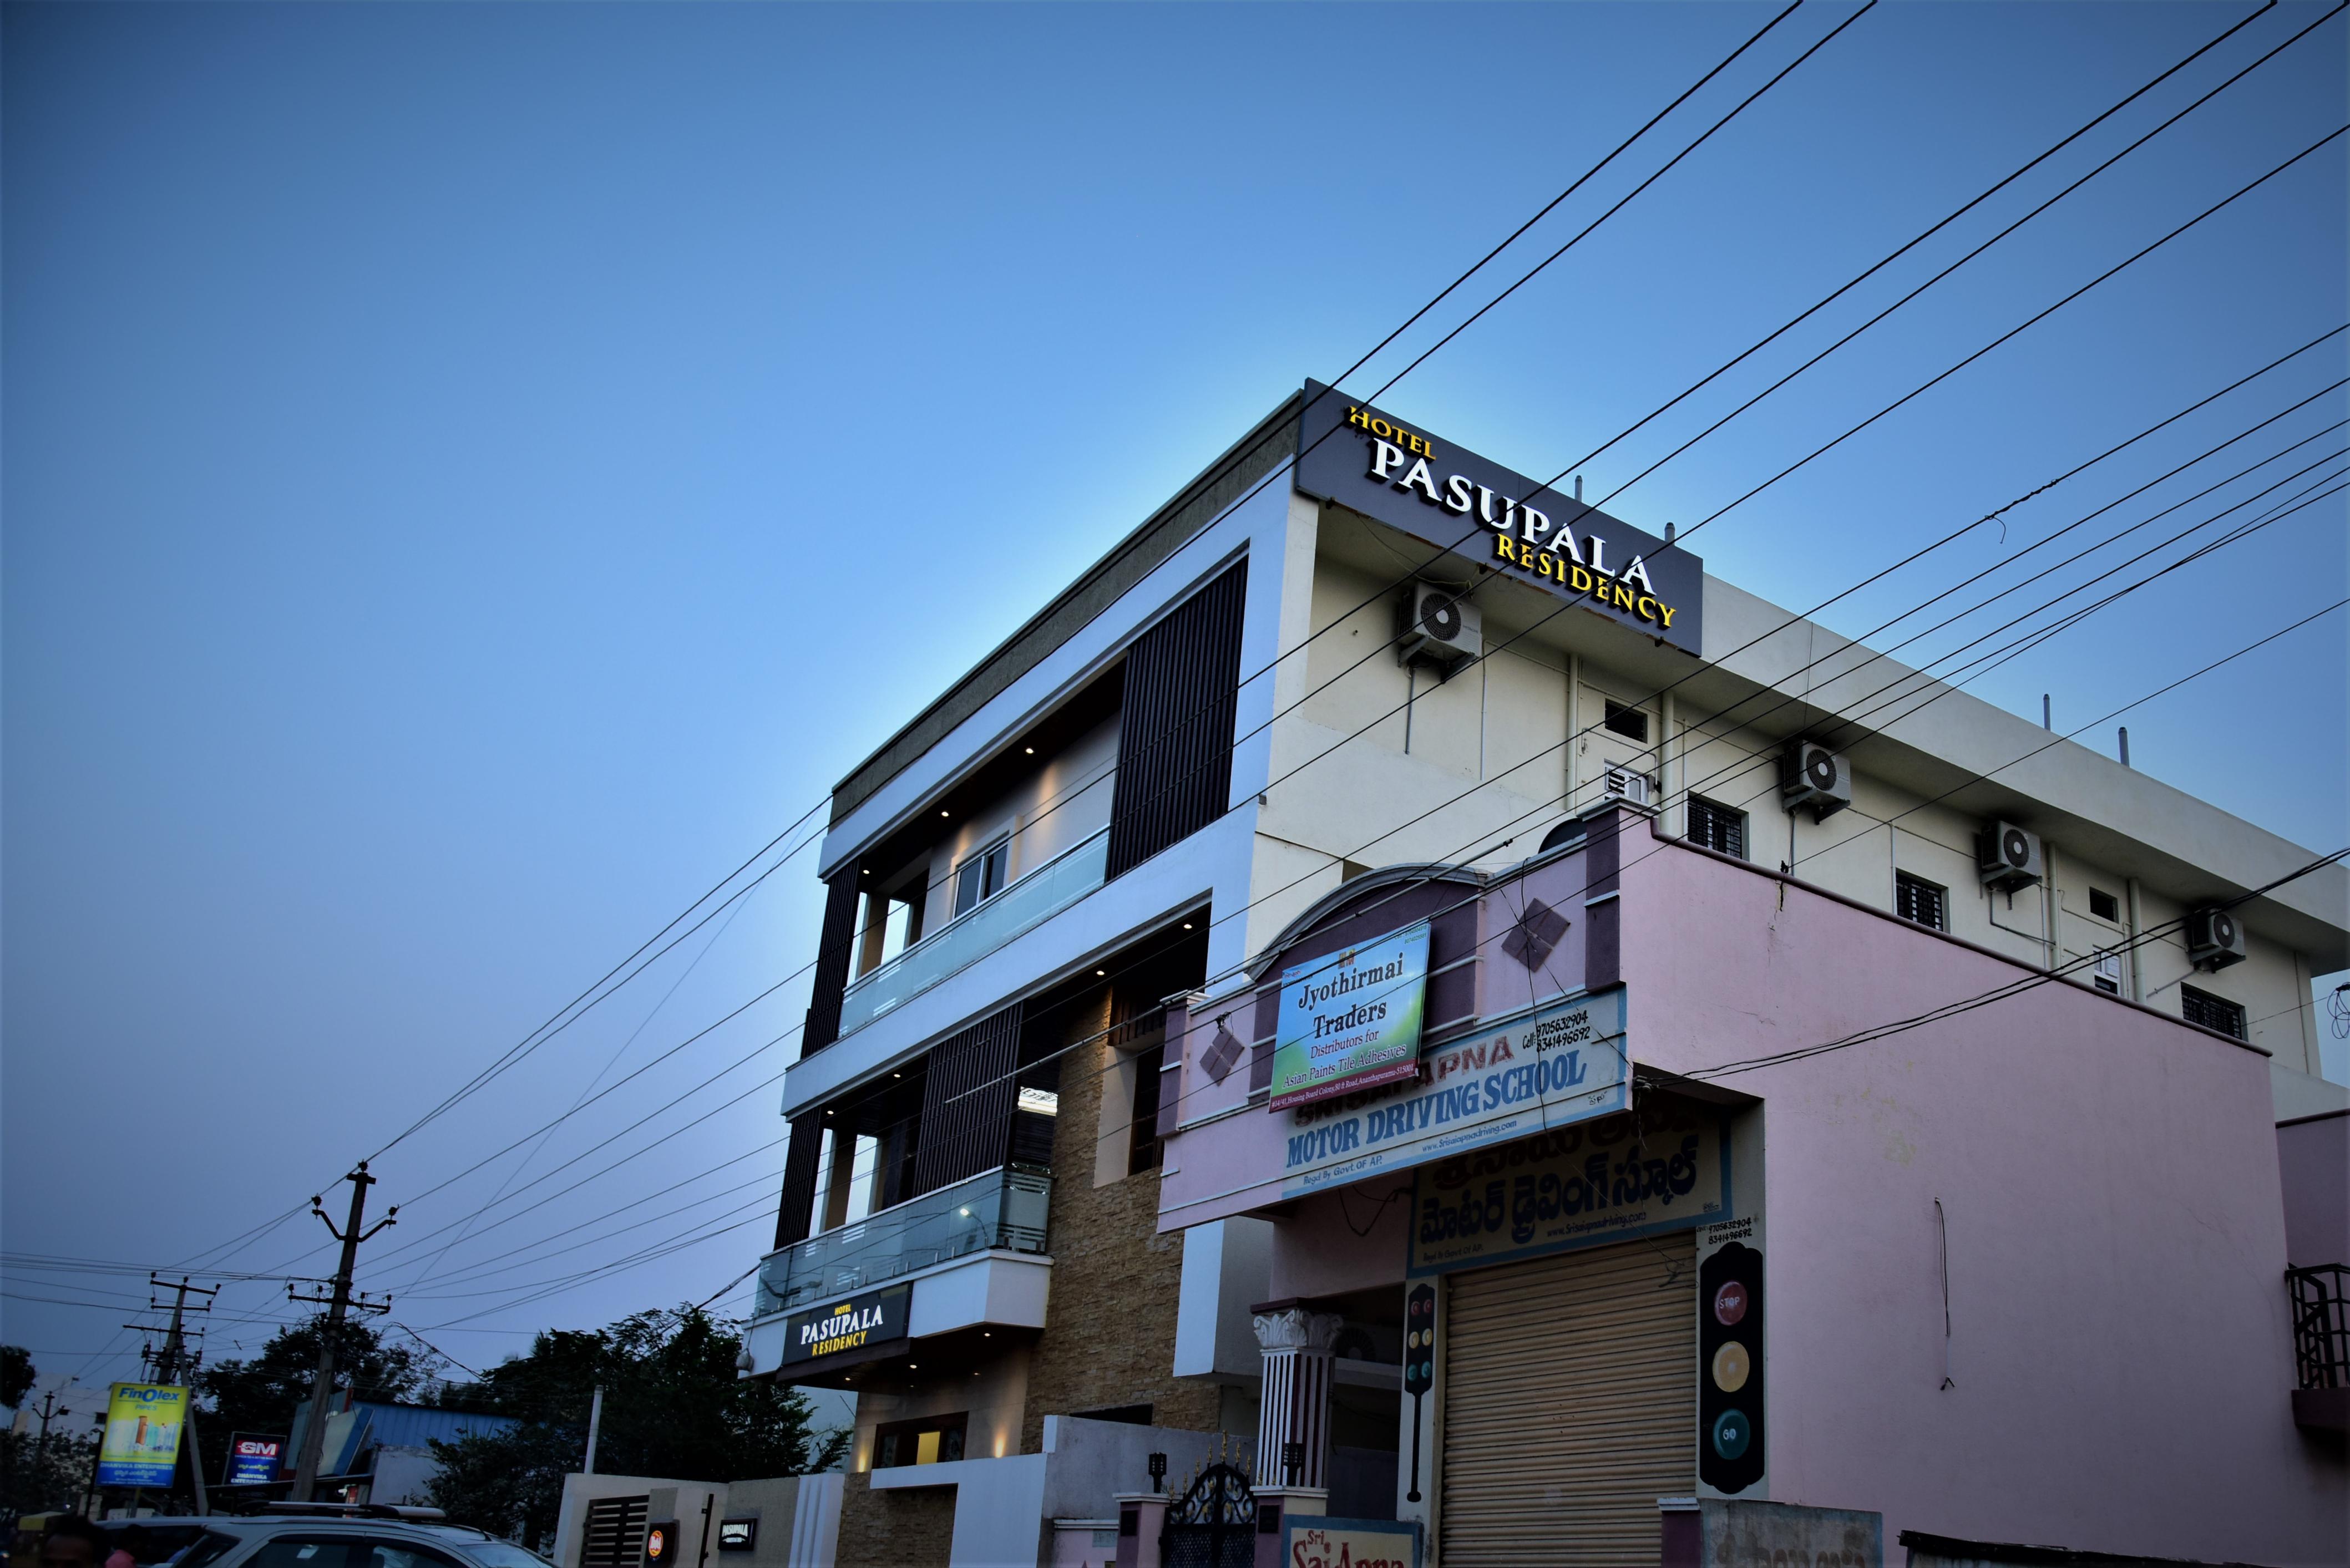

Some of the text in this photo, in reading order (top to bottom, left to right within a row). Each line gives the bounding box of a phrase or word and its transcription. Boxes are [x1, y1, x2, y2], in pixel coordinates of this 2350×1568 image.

[1348, 406, 1437, 460] HOTEL
[1370, 437, 1657, 596] PASUPALA
[1496, 534, 1677, 628] RESIDENCY
[1298, 952, 1404, 1011] Jyothirmai
[1313, 1001, 1387, 1039] Traders
[1536, 1009, 1589, 1038] 9705632904
[1310, 1029, 1379, 1059] Distributors for
[1522, 1032, 1536, 1049] Cell:
[1536, 1026, 1591, 1053] 8341496692
[1283, 1044, 1406, 1089] Asian Paints Tile Adhesives
[1411, 1036, 1515, 1089] APNA
[1286, 1049, 1587, 1168] MOTOR DRIVING SCHOOL
[1303, 1172, 1321, 1185] Regd
[1323, 1170, 1331, 1181] By
[1356, 1159, 1367, 1170] OF
[1708, 1227, 1753, 1245] 8341496692
[1709, 1216, 1752, 1234] 9705632904
[834, 1304, 852, 1316] HOTEL
[1719, 1296, 1740, 1309] STOP
[801, 1305, 883, 1345] PASUPALA
[812, 1331, 867, 1356] RESIDENCY
[239, 1441, 277, 1455] GM
[1723, 1428, 1736, 1440] GO
[1307, 1530, 1325, 1545] Sri
